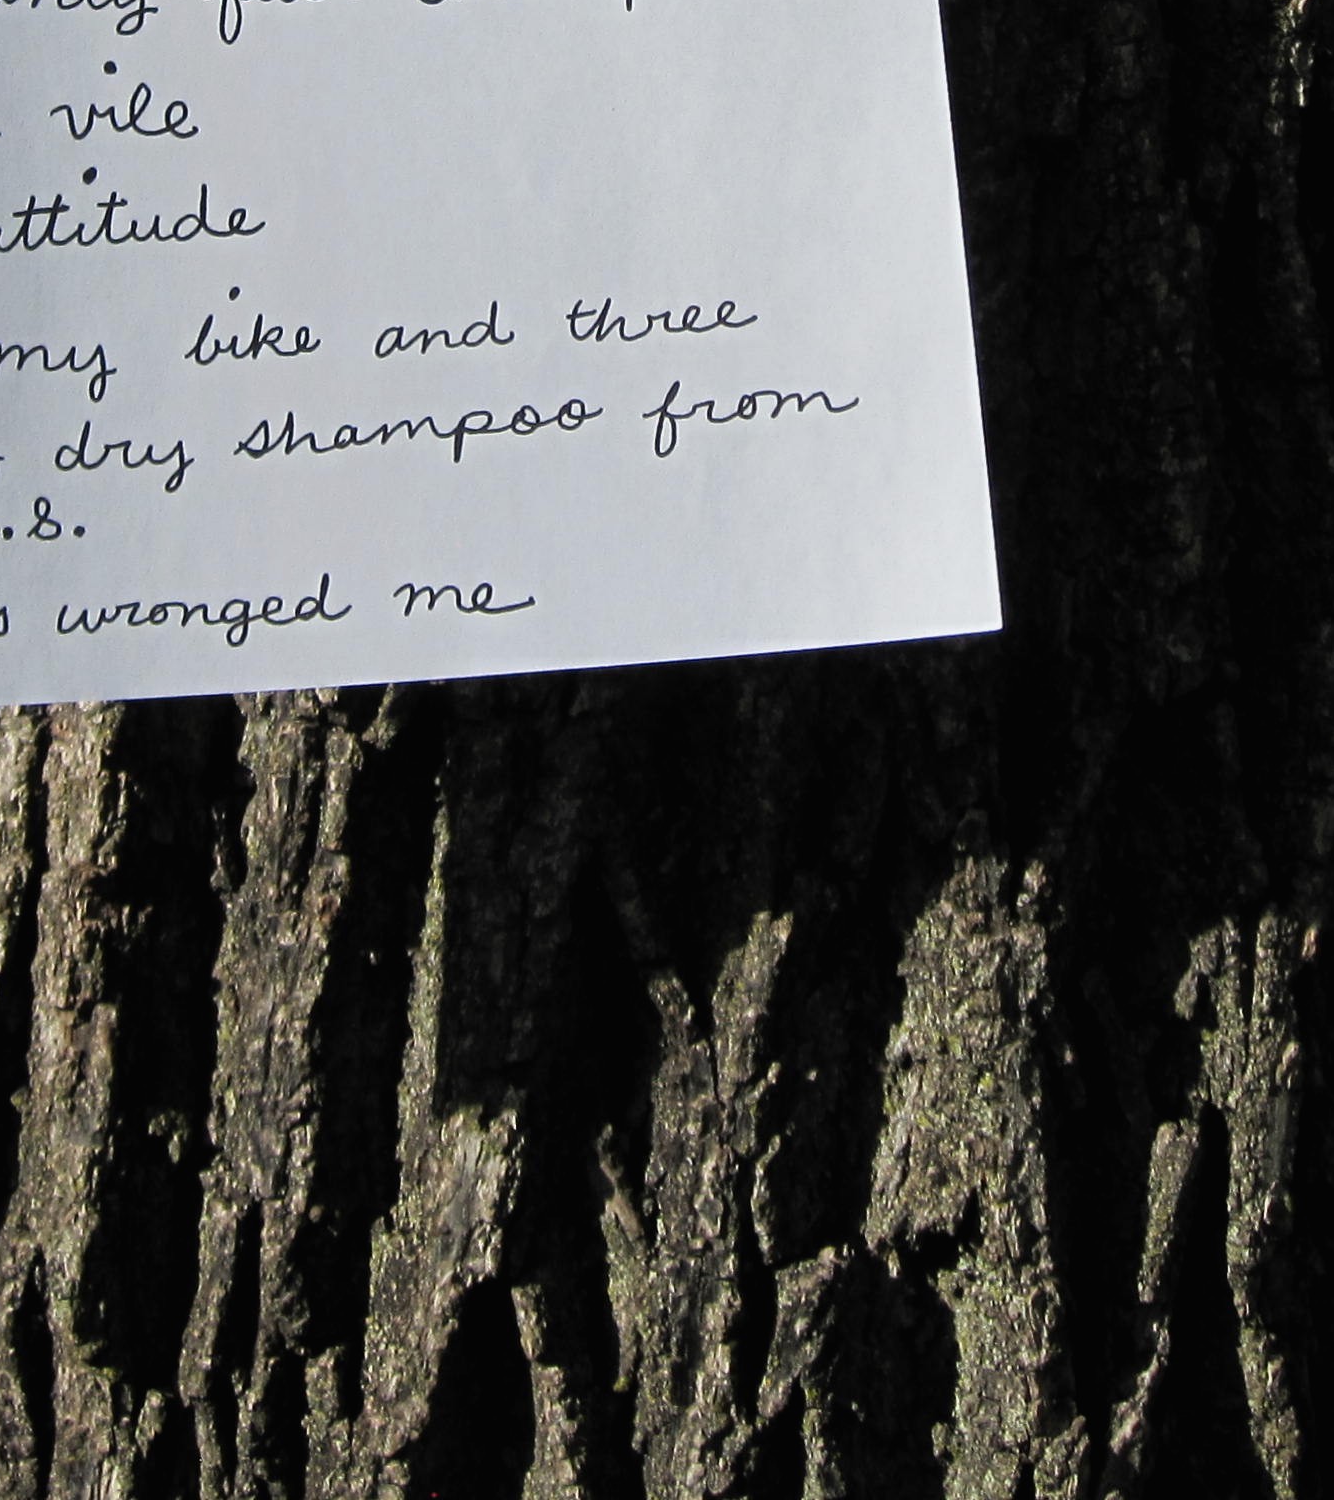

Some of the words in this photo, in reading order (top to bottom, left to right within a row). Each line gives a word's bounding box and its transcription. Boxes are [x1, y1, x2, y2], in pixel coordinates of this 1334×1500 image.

[49, 60, 200, 141] vile
[184, 285, 322, 366] bike
[374, 300, 515, 359] and
[565, 297, 759, 343] three
[54, 419, 195, 494] dry
[233, 398, 604, 464] shampoo
[641, 379, 860, 459] from
[56, 572, 353, 648] wronged
[392, 582, 536, 617] me
